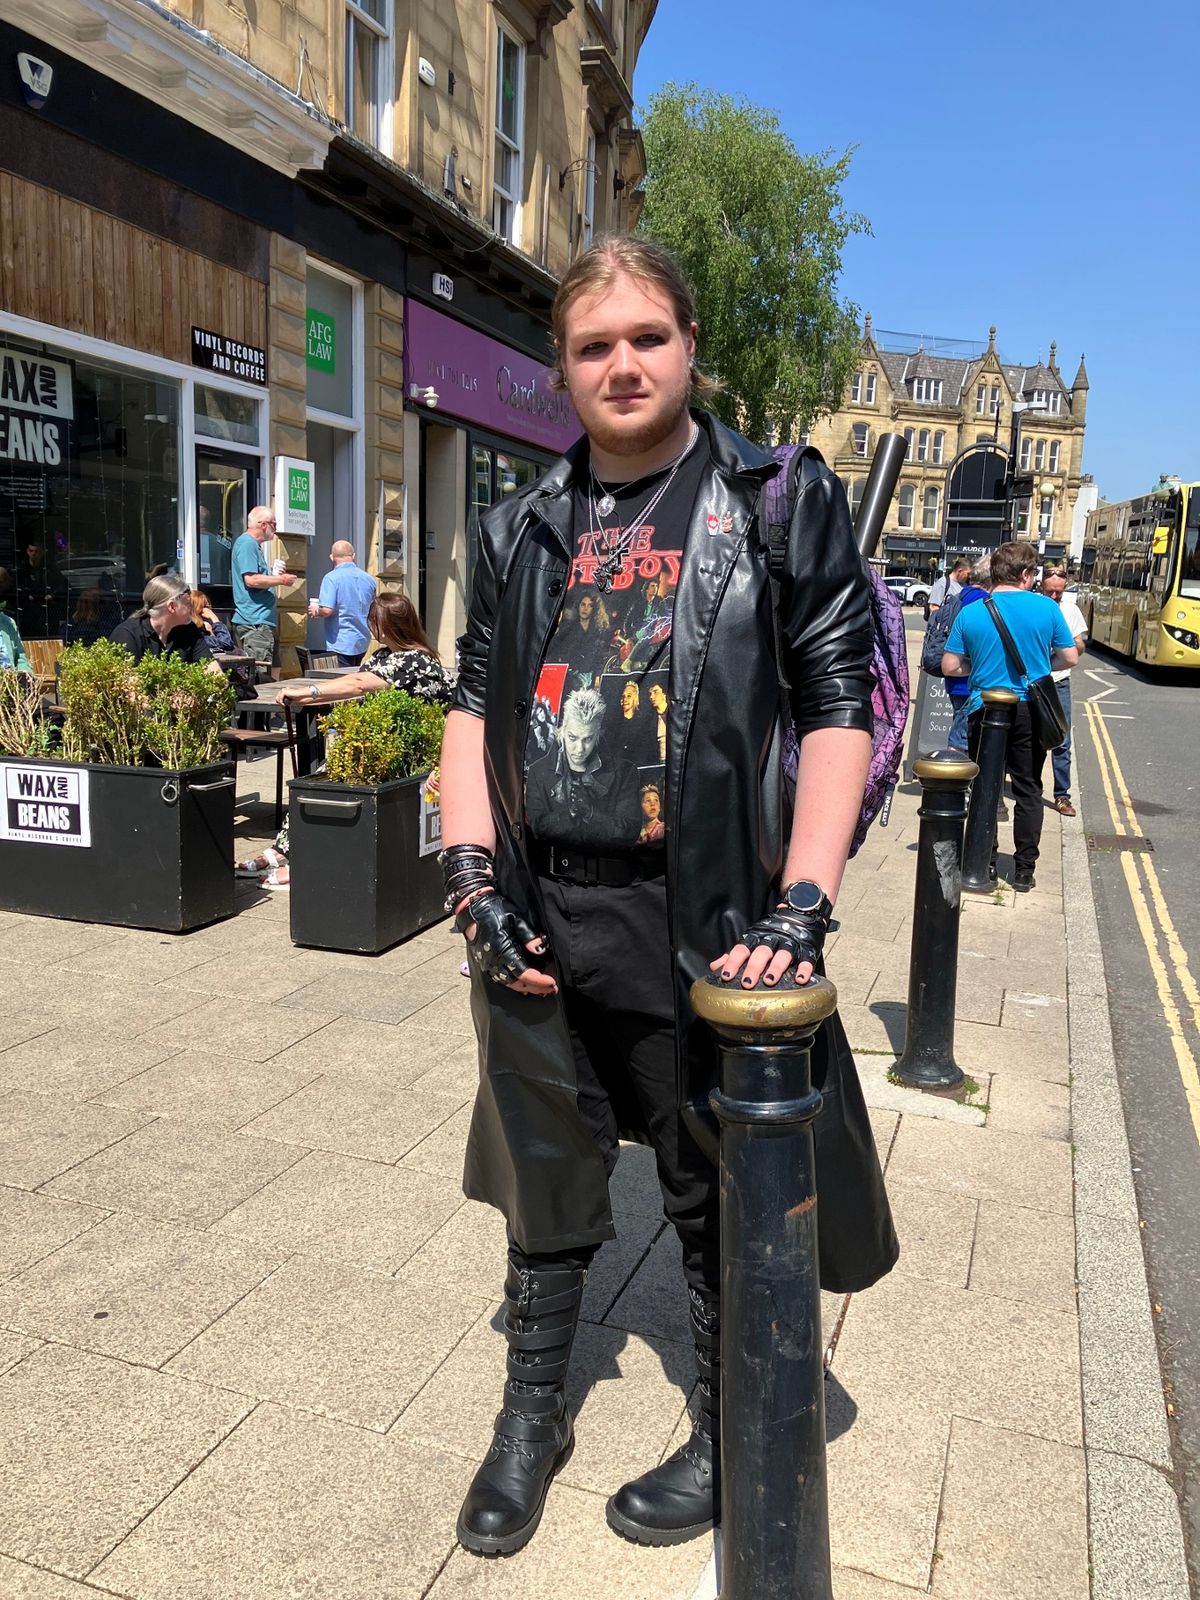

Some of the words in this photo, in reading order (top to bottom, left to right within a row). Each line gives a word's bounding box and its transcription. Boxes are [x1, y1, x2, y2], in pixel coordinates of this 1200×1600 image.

[308, 320, 332, 344] AFG
[194, 329, 222, 352] VINYL
[225, 340, 265, 366] RECORDS
[308, 338, 332, 361] LAW
[212, 353, 231, 371] AND
[234, 360, 265, 382] COFFEE
[40, 364, 58, 409] AND
[290, 475, 308, 490] AFG
[290, 488, 308, 502] LAW
[577, 524, 656, 558] THE
[17, 773, 57, 798] WAX
[57, 776, 68, 799] AND
[17, 803, 70, 831] BEANS
